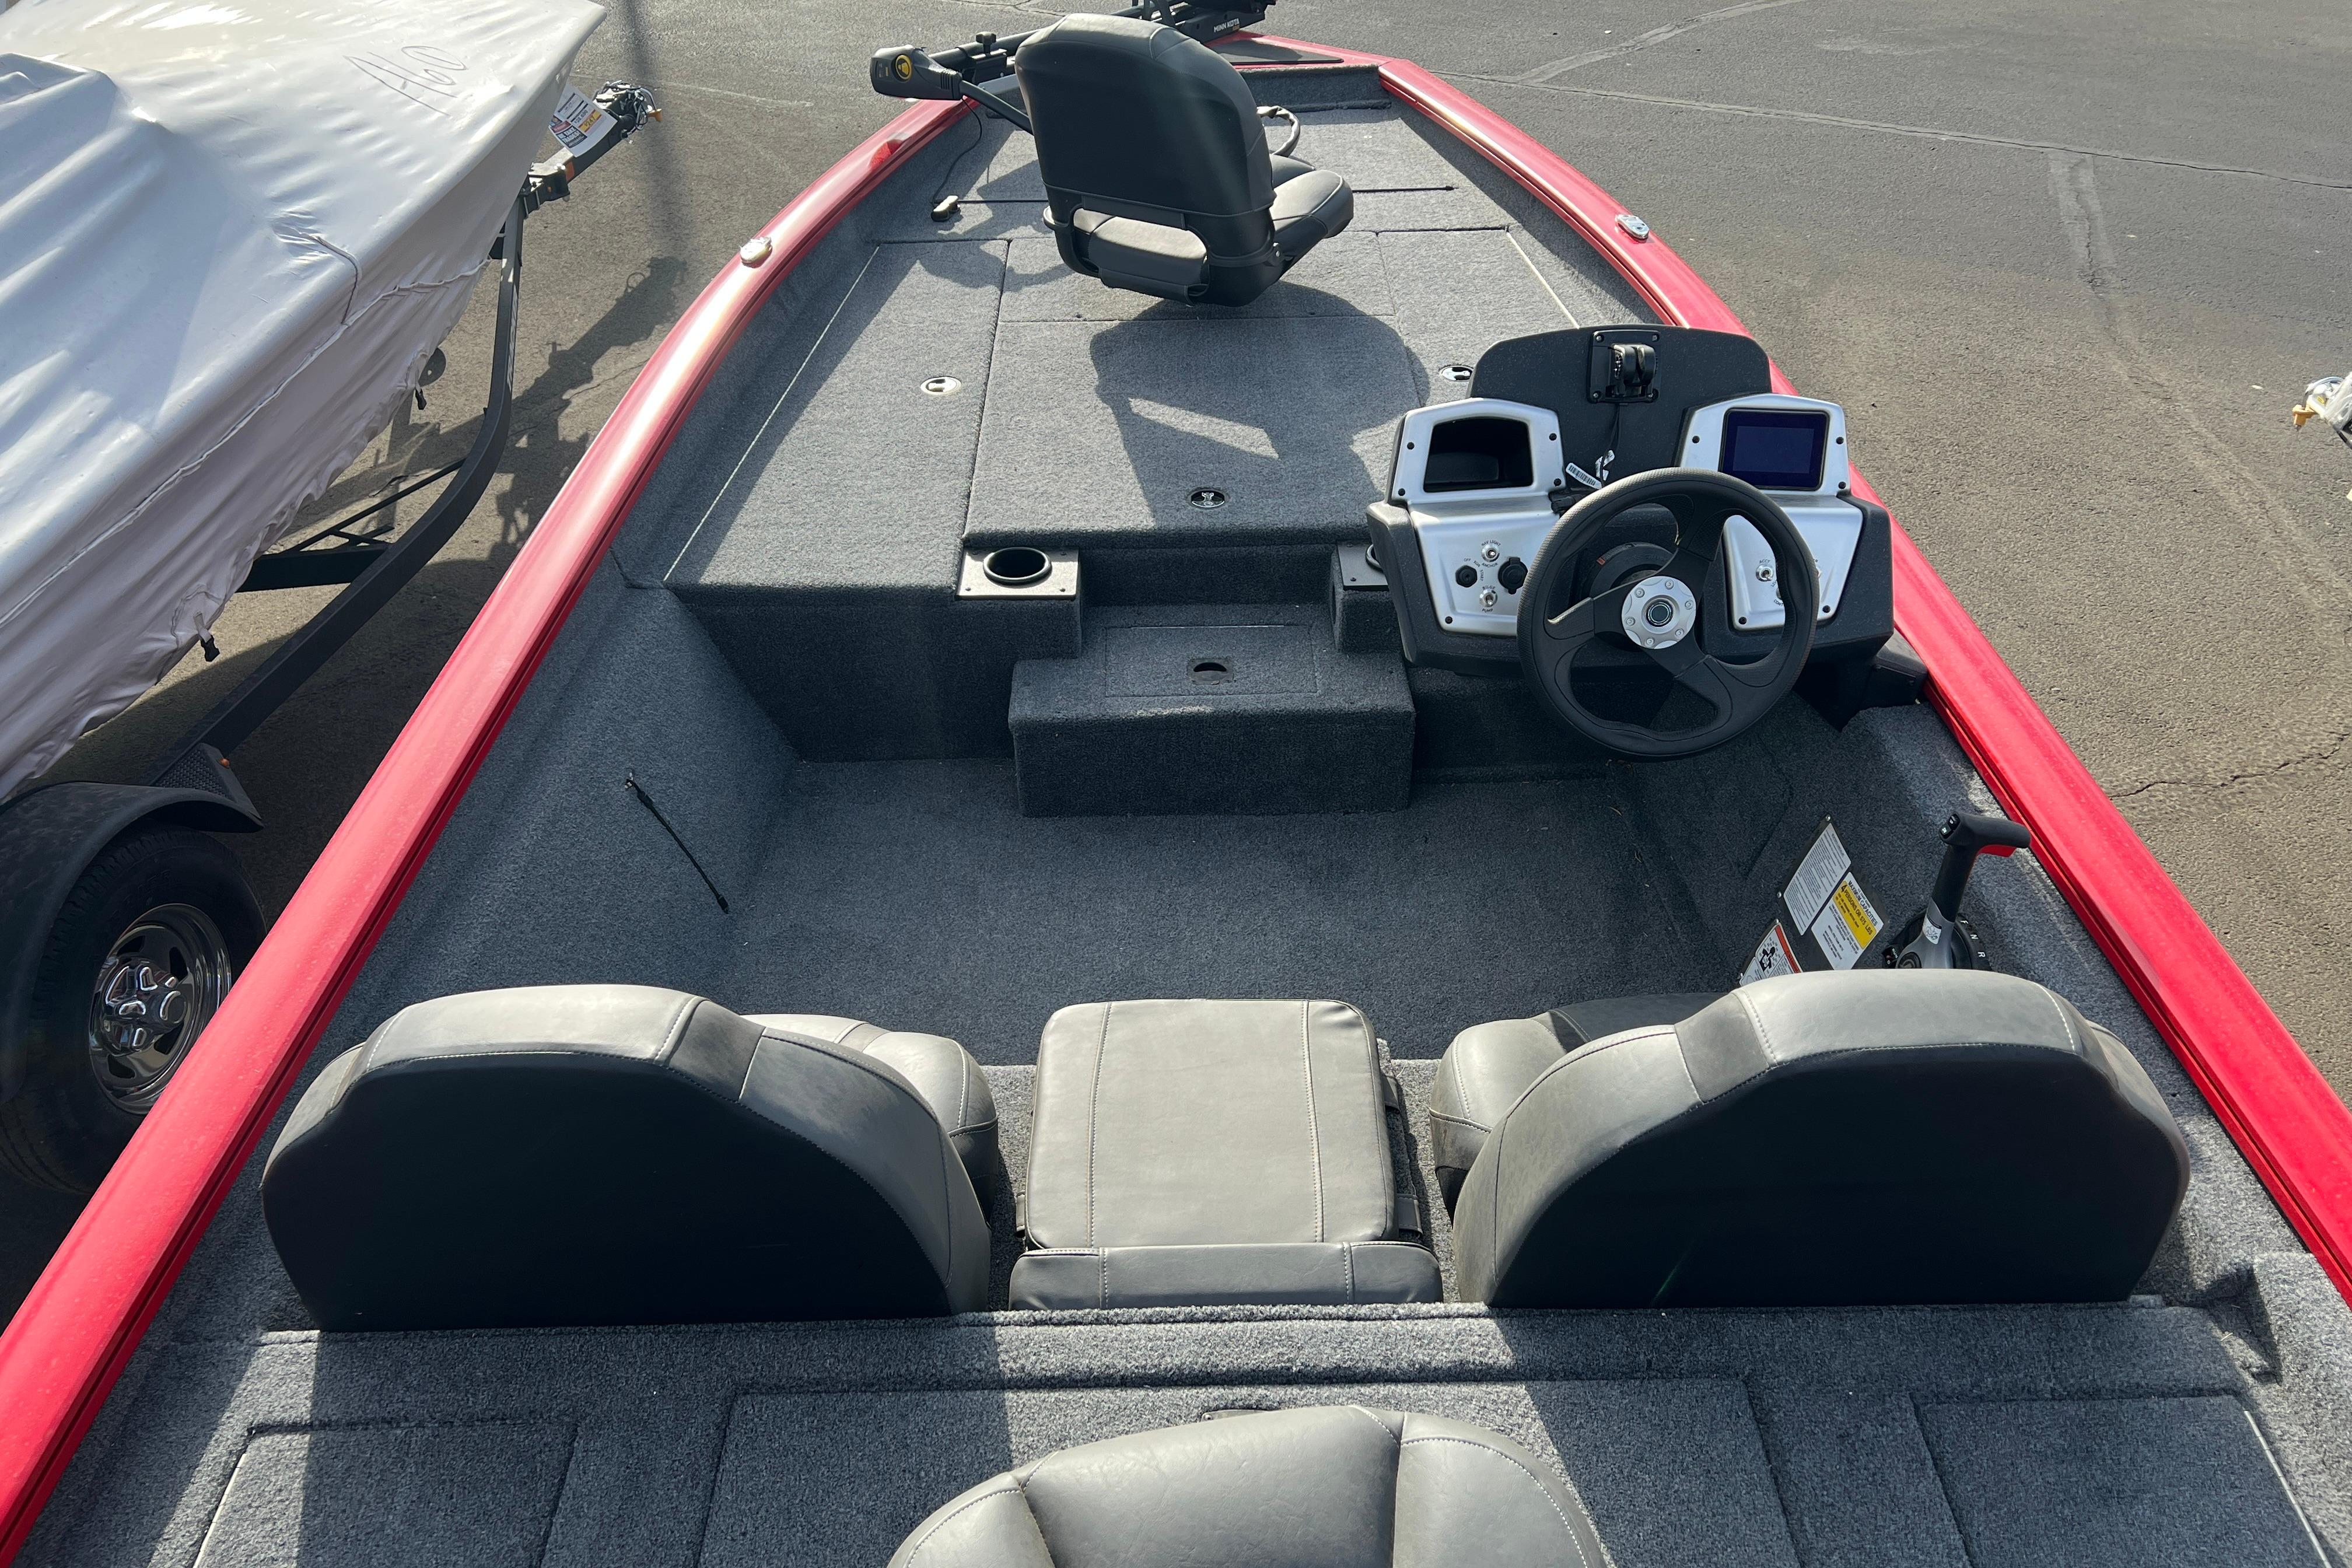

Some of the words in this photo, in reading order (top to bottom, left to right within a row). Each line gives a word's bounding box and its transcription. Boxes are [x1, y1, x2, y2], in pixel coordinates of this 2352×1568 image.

[1214, 23, 1226, 33] MINN
[1227, 18, 1240, 28] KOTA
[1841, 884, 1847, 892] 4
[1844, 889, 1857, 911] PERSONS
[1856, 909, 1861, 918] OR
[1865, 924, 1873, 935] LBS
[1848, 880, 1863, 902] MAXIMUM
[1860, 900, 1878, 927] CAPACITIES
